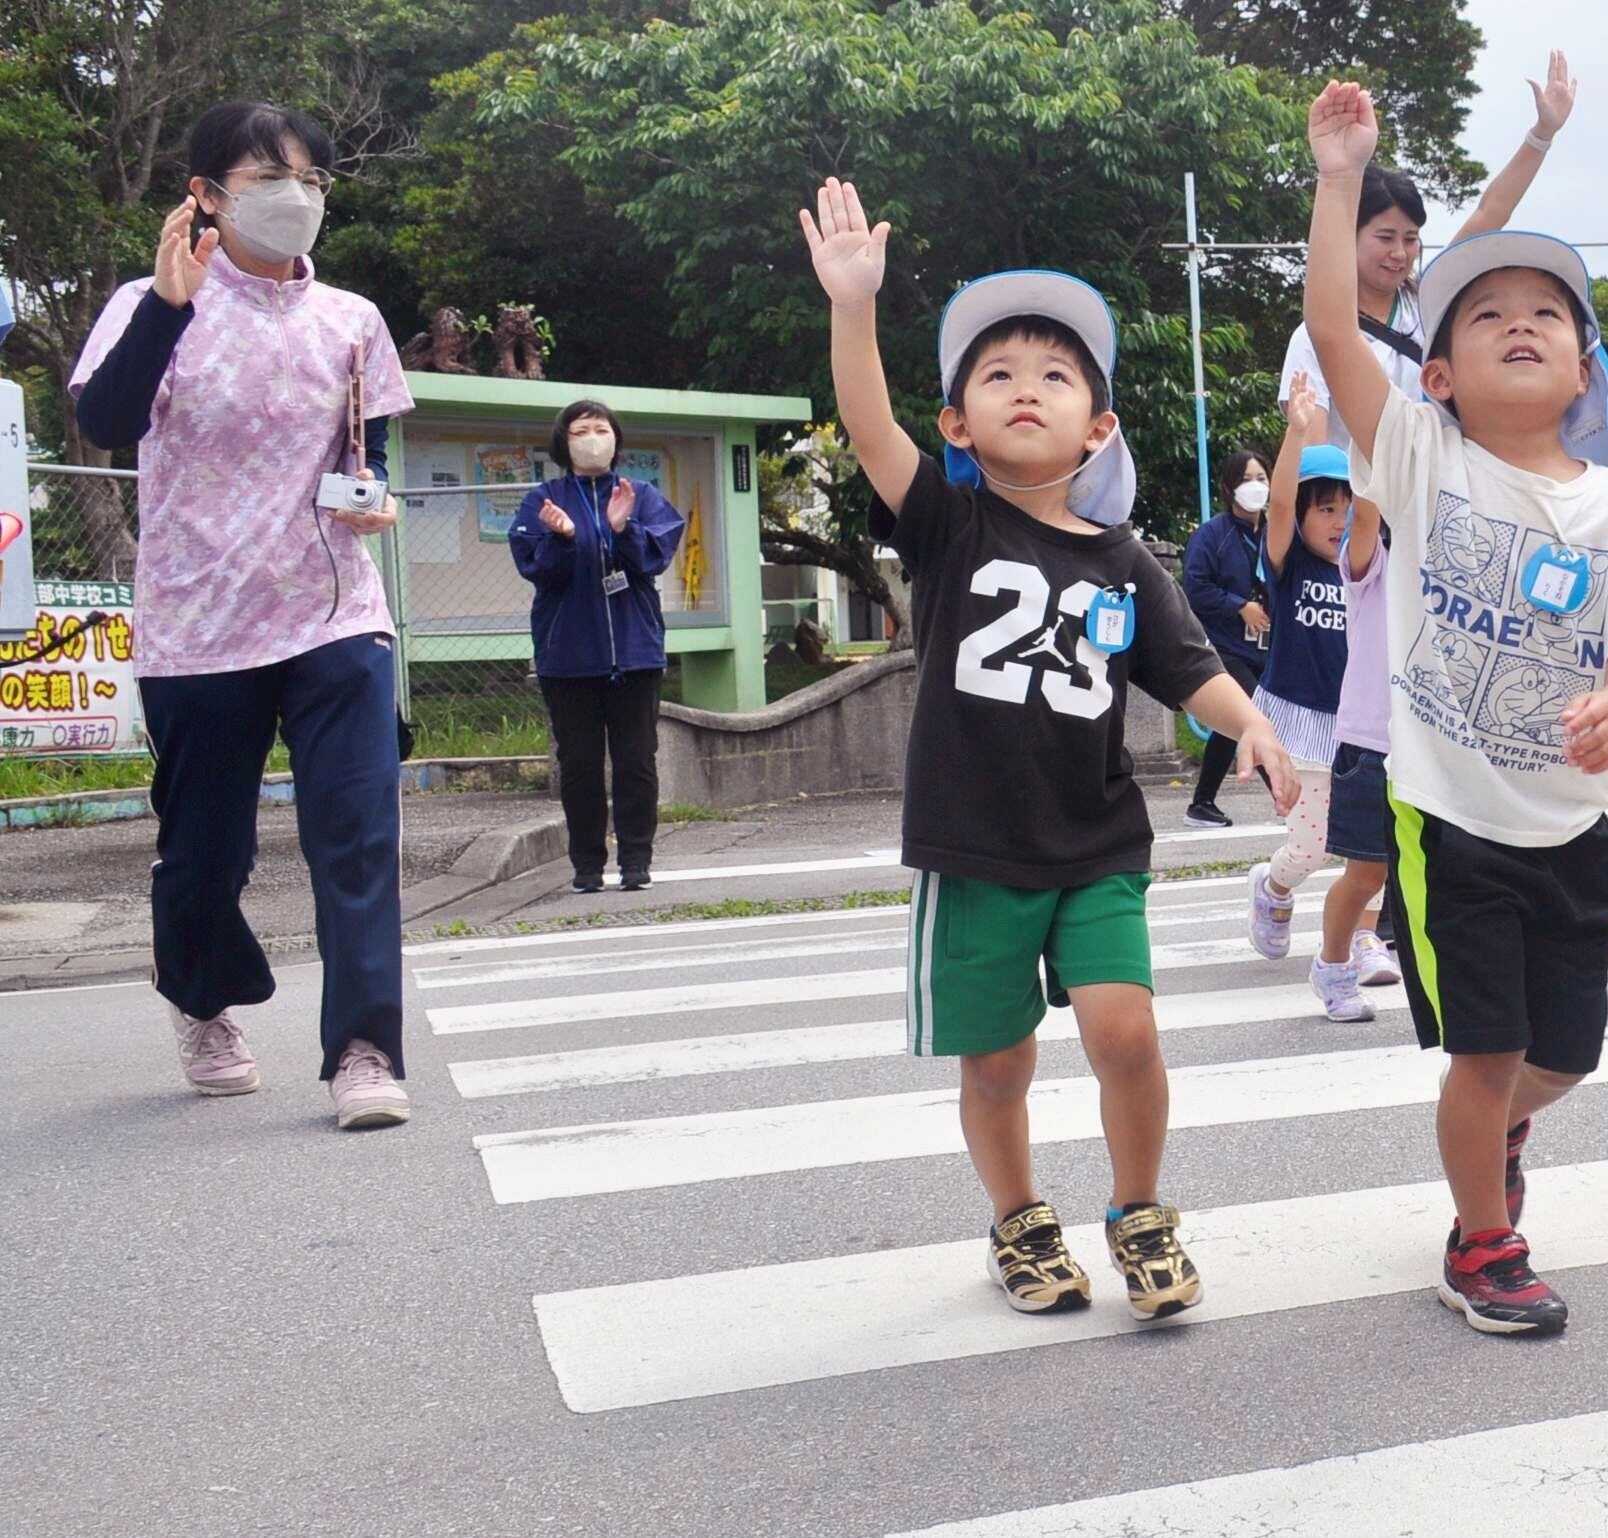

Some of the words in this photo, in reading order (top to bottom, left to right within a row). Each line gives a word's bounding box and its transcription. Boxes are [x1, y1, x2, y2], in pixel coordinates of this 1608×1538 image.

[34, 583, 132, 606] 部中学校コミ
[955, 558, 1113, 720] 23
[0, 726, 35, 749] 康力
